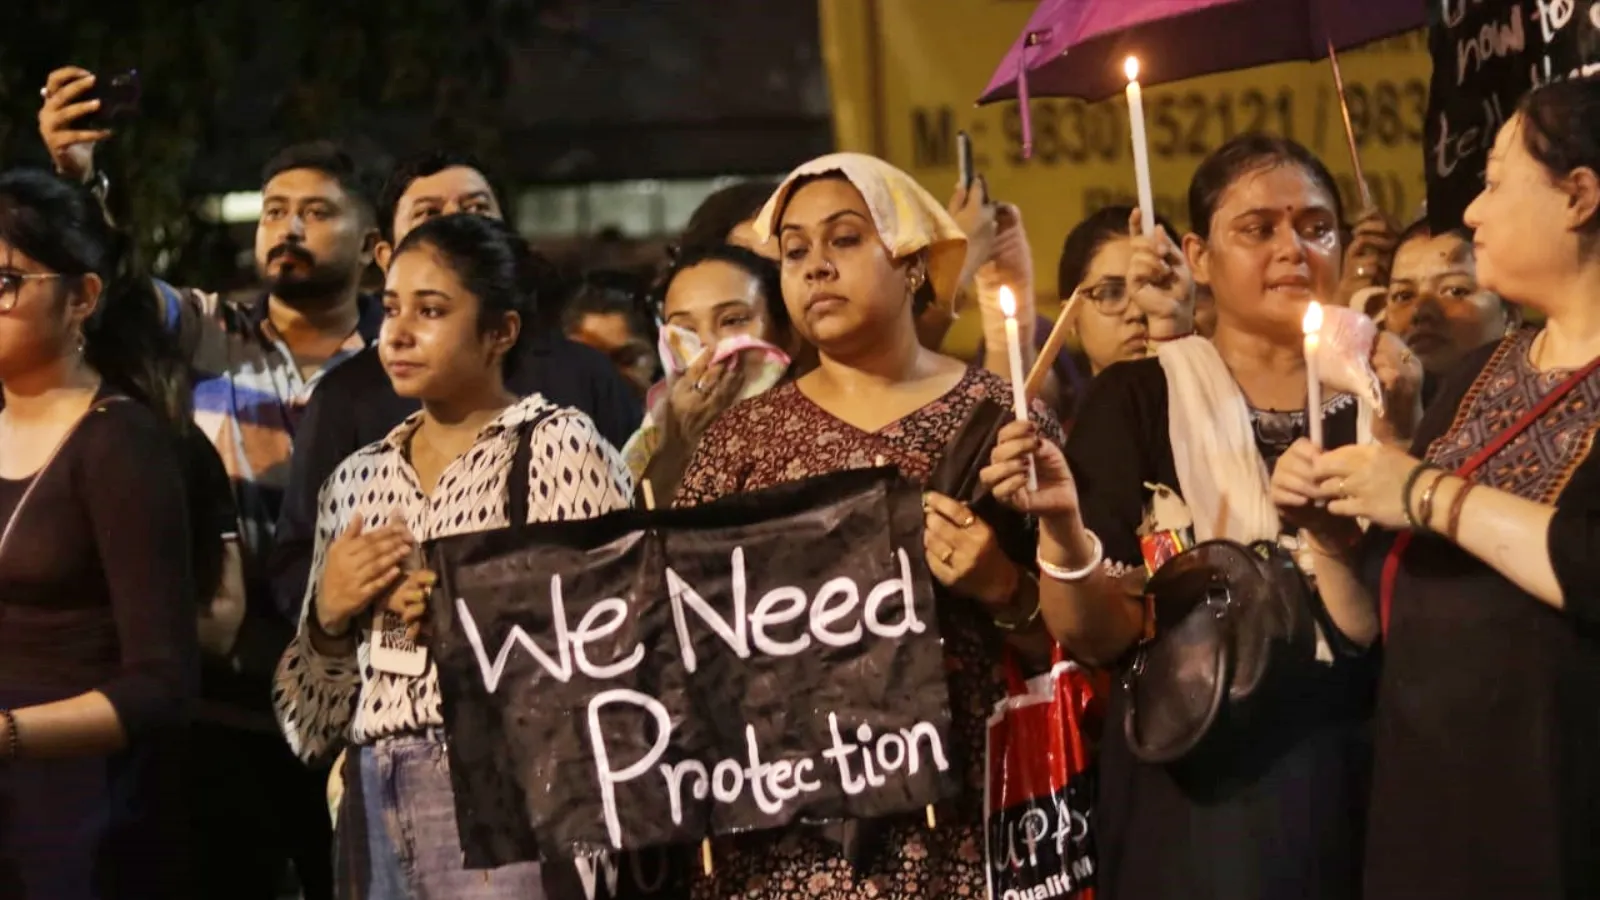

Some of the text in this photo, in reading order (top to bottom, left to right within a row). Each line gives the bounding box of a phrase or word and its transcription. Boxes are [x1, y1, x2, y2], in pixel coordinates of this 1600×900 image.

[455, 546, 926, 693] We Need
[586, 688, 949, 849] Protection
